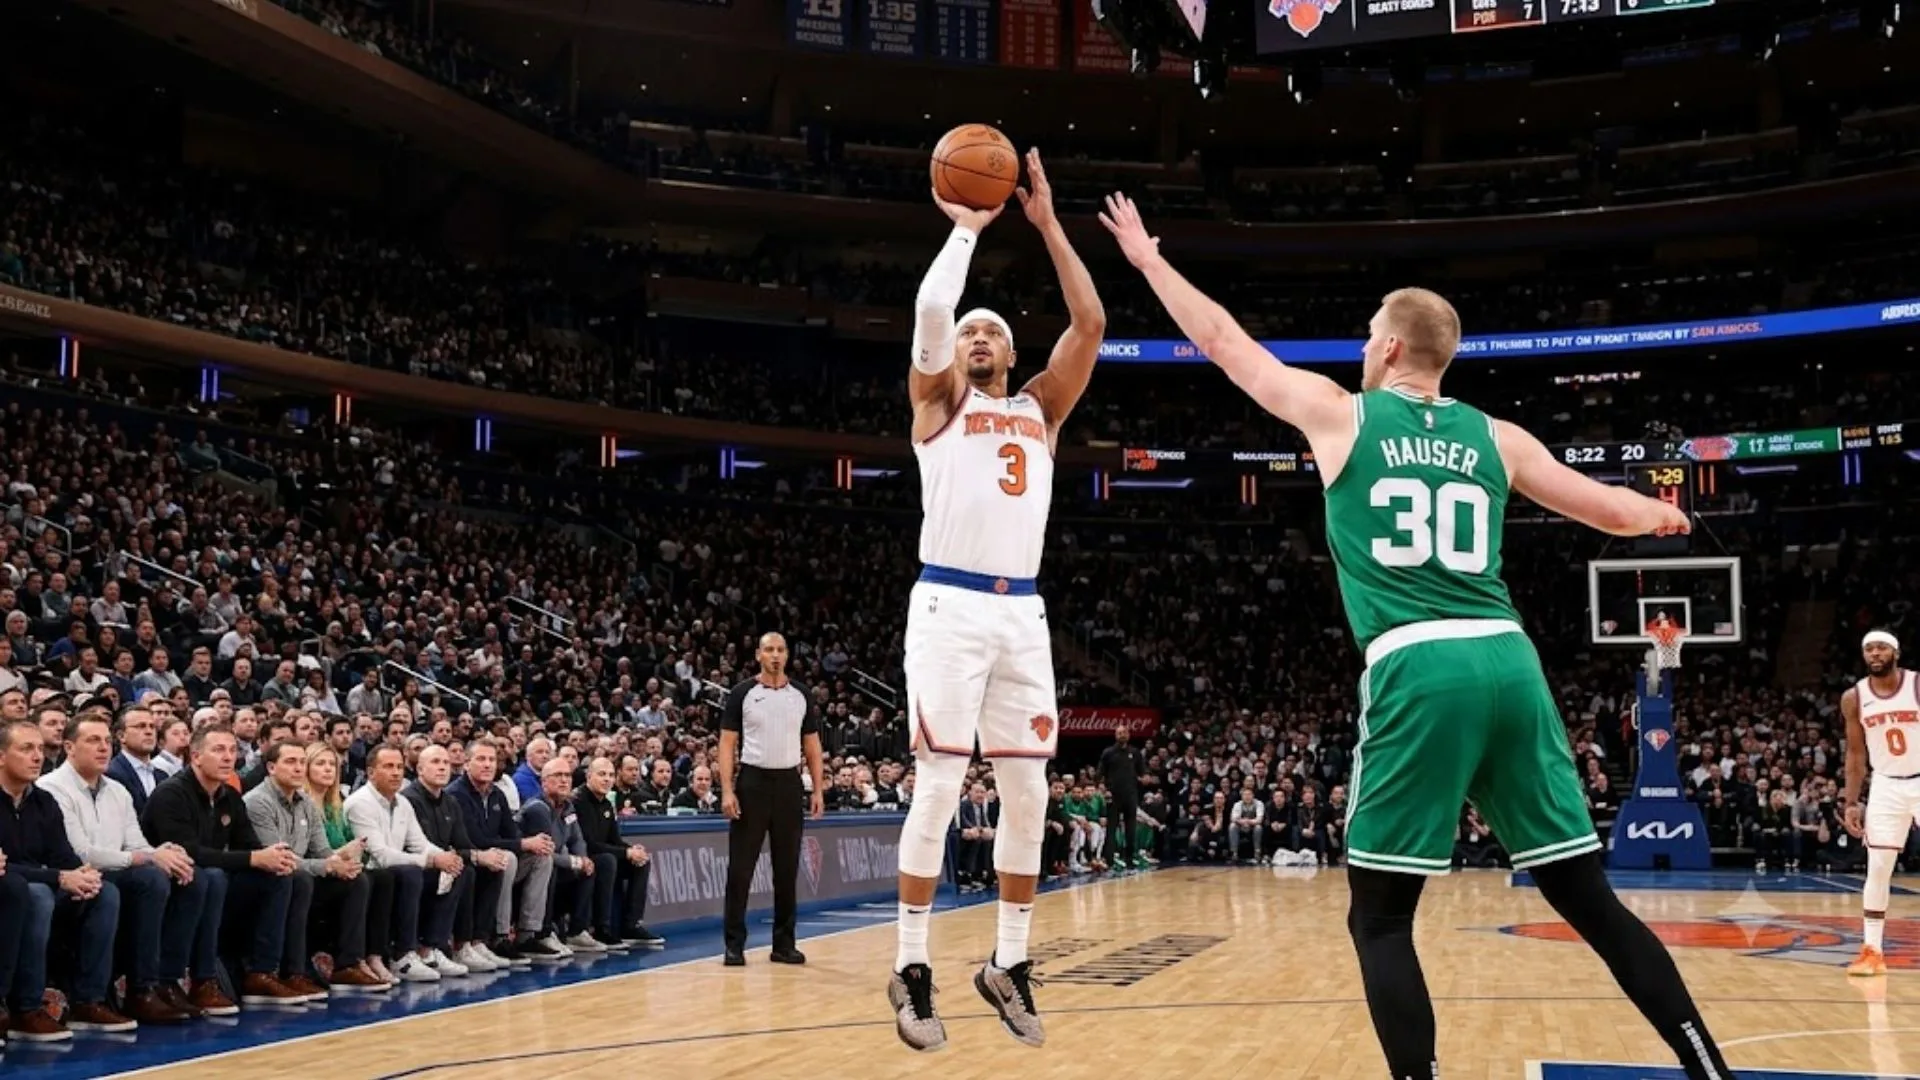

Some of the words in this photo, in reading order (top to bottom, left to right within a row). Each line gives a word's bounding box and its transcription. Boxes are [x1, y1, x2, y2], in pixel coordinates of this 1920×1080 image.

[1523, 3, 1533, 19] 7
[1380, 436, 1480, 477] HAUSER
[1565, 447, 1605, 463] 8:22
[1621, 444, 1645, 460] 20
[997, 442, 1027, 497] 3
[1370, 477, 1490, 574] 30
[1059, 708, 1152, 731] Budweiser
[1886, 727, 1907, 756] 0
[1627, 820, 1694, 840] KIA
[657, 847, 700, 904] NBA
